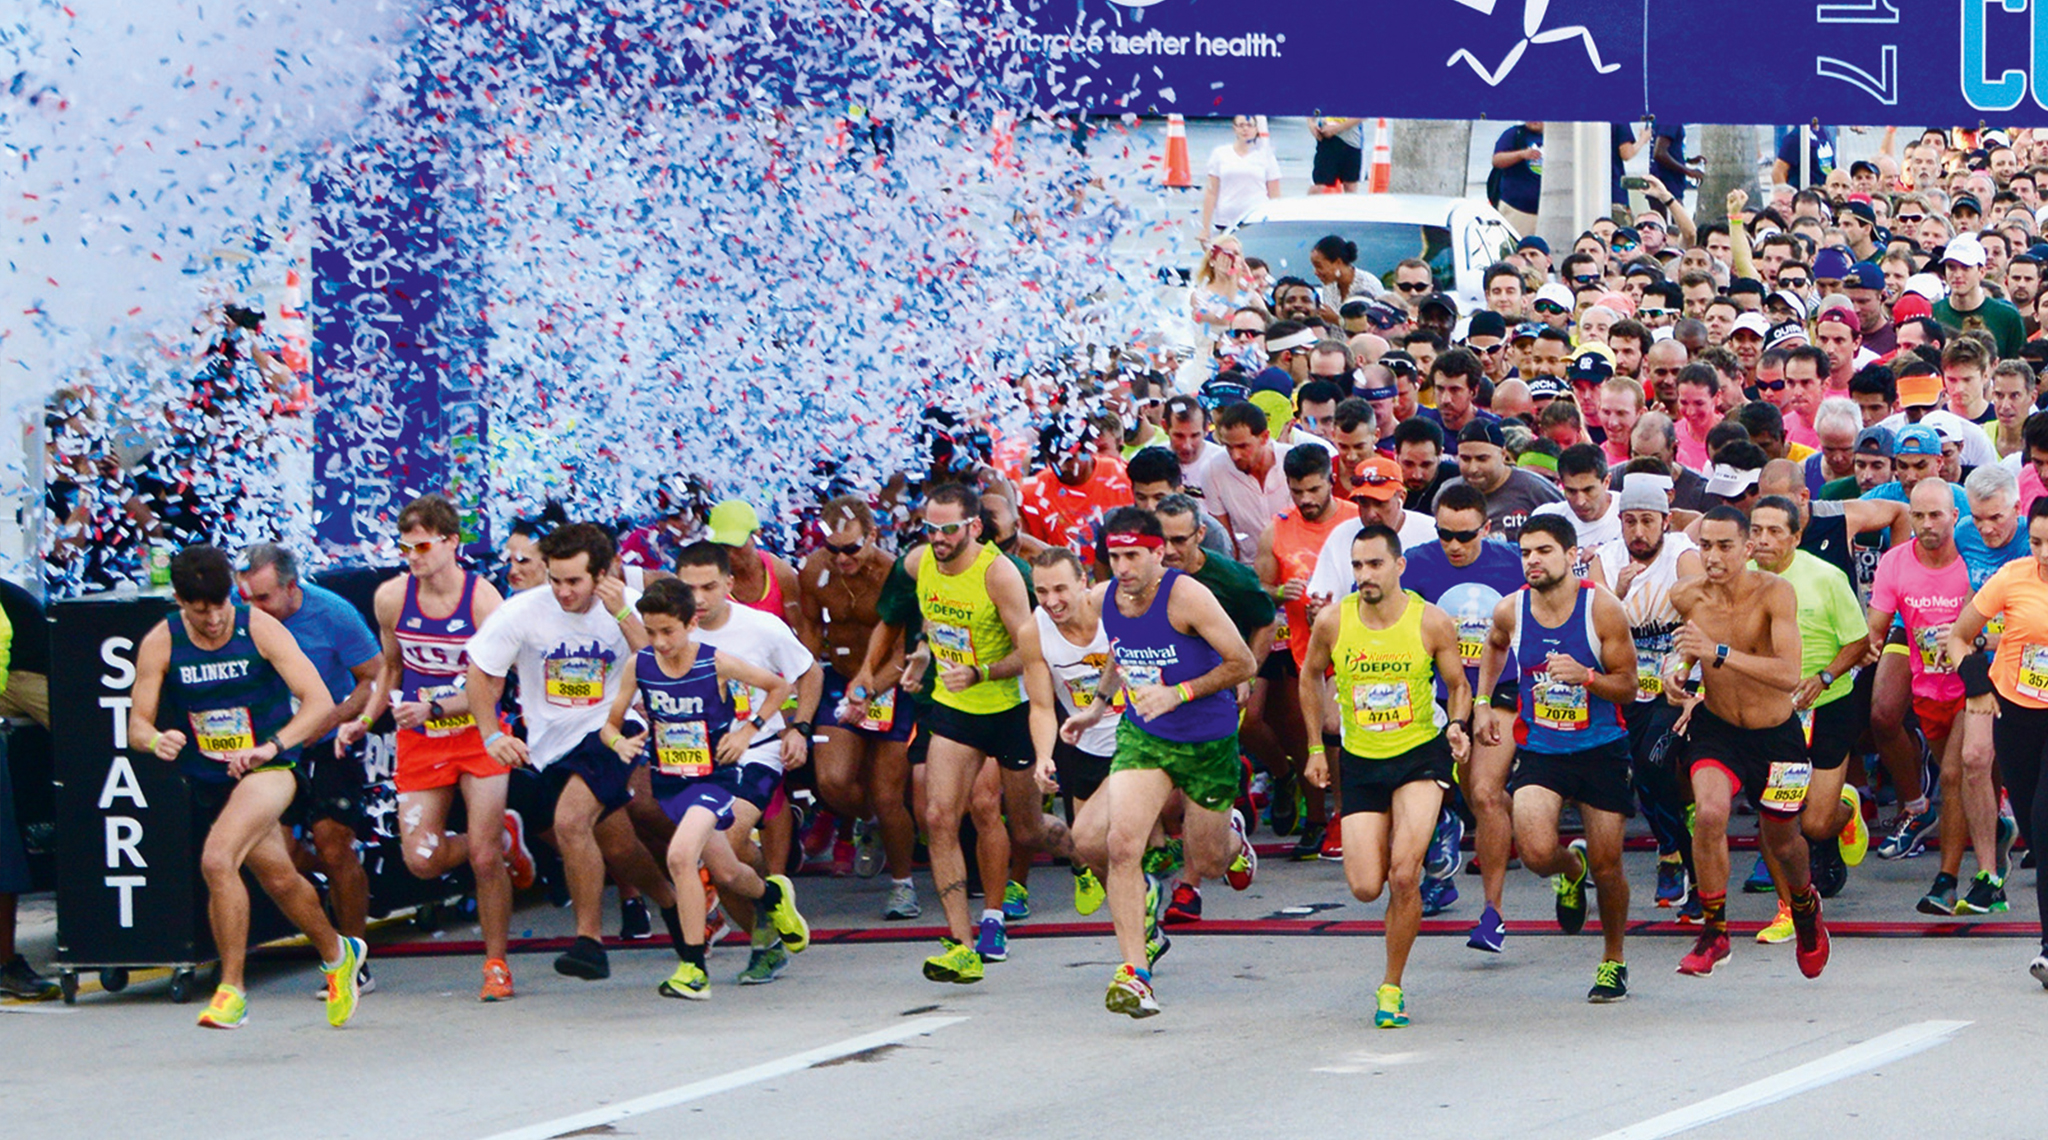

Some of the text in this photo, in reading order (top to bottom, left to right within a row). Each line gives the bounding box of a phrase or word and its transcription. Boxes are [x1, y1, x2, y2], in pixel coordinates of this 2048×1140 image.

[1110, 30, 1190, 55] better
[1950, 0, 2048, 111] C
[1932, 596, 1958, 608] Med
[934, 603, 974, 620] DEPOT
[1116, 644, 1177, 659] Carnival
[179, 659, 250, 684] BLINKEY
[1361, 662, 1411, 673] DEPOT
[1368, 710, 1400, 722] 4714
[1544, 708, 1576, 721] 7078
[664, 750, 703, 764] 13076
[98, 636, 149, 928] START
[1774, 789, 1804, 800] 8534
